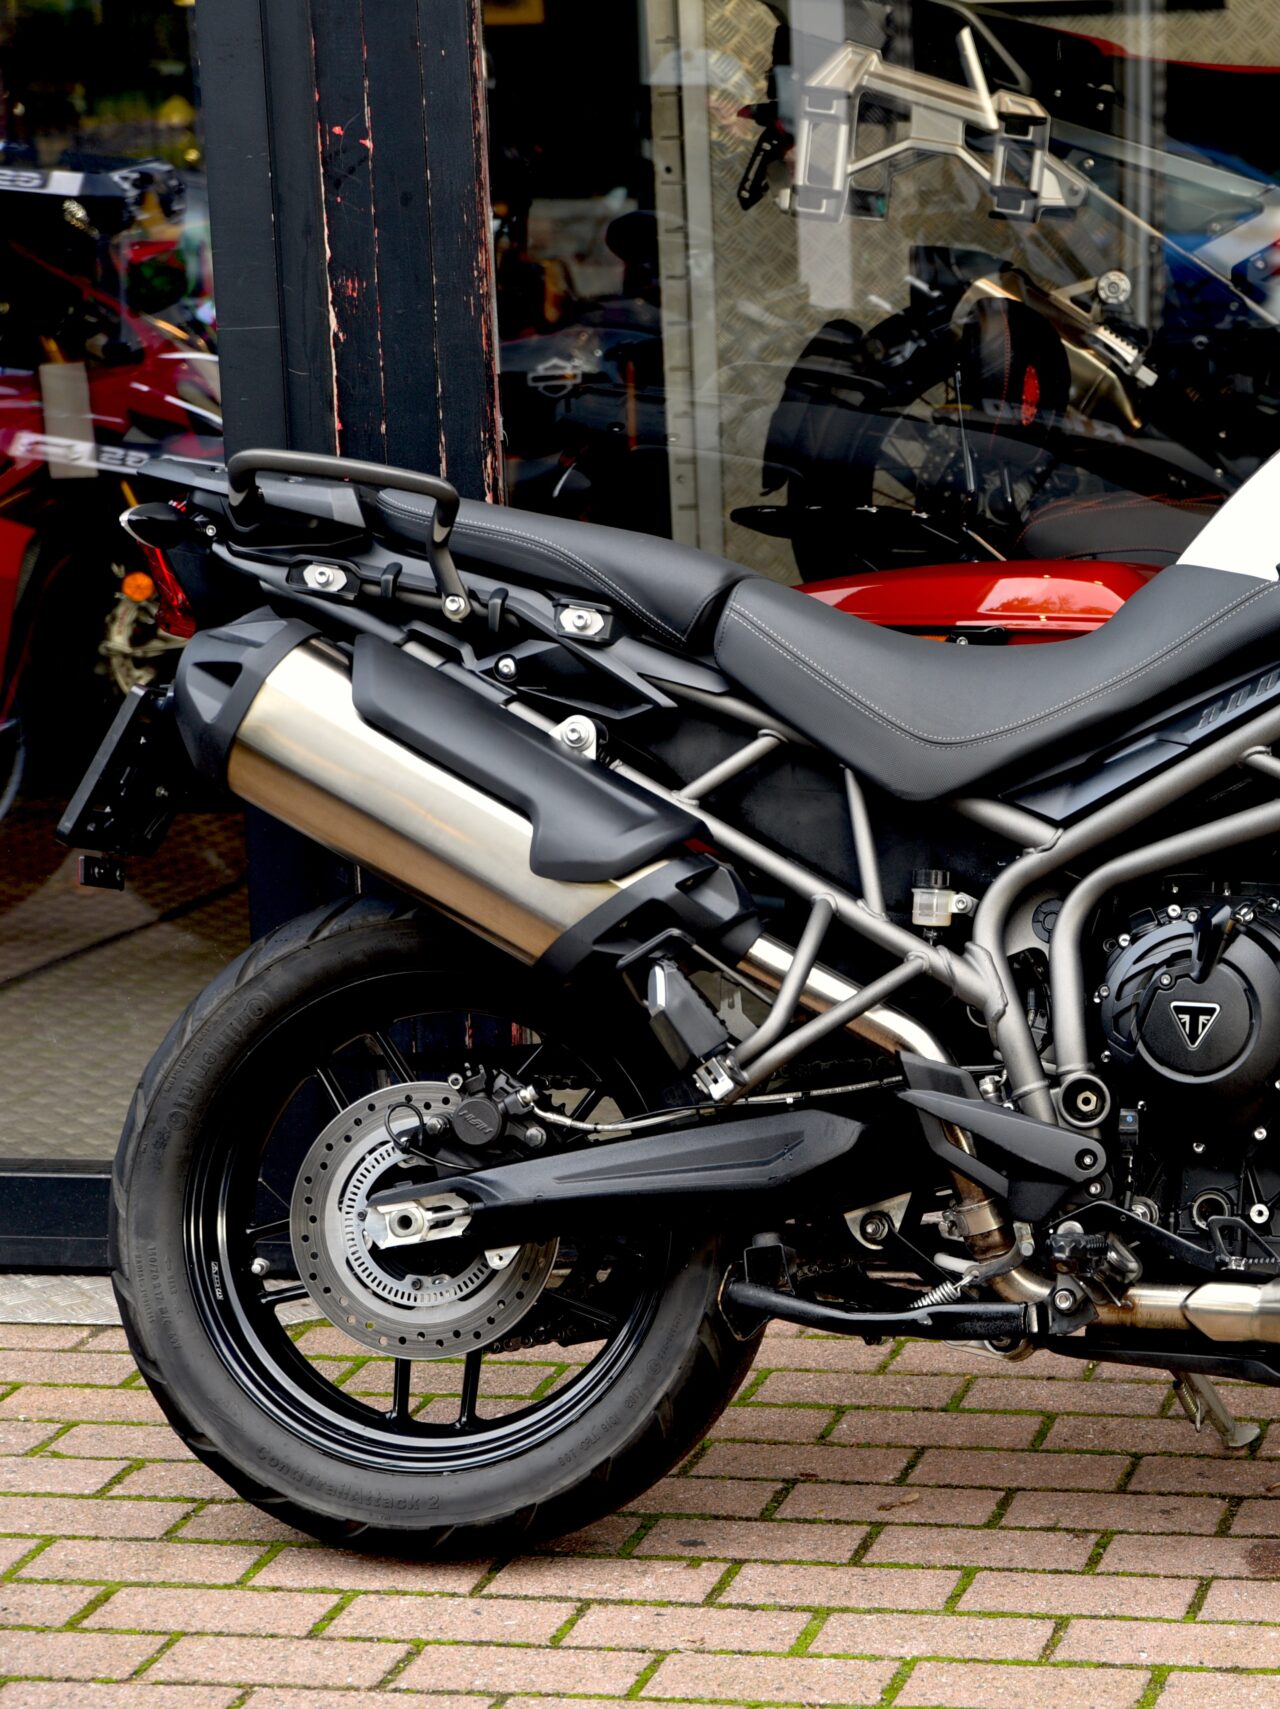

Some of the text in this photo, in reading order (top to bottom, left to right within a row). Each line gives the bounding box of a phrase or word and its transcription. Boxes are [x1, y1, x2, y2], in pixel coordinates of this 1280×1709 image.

[1198, 667, 1280, 730] 800
[254, 1443, 440, 1512] ContiTrailAttack 2
